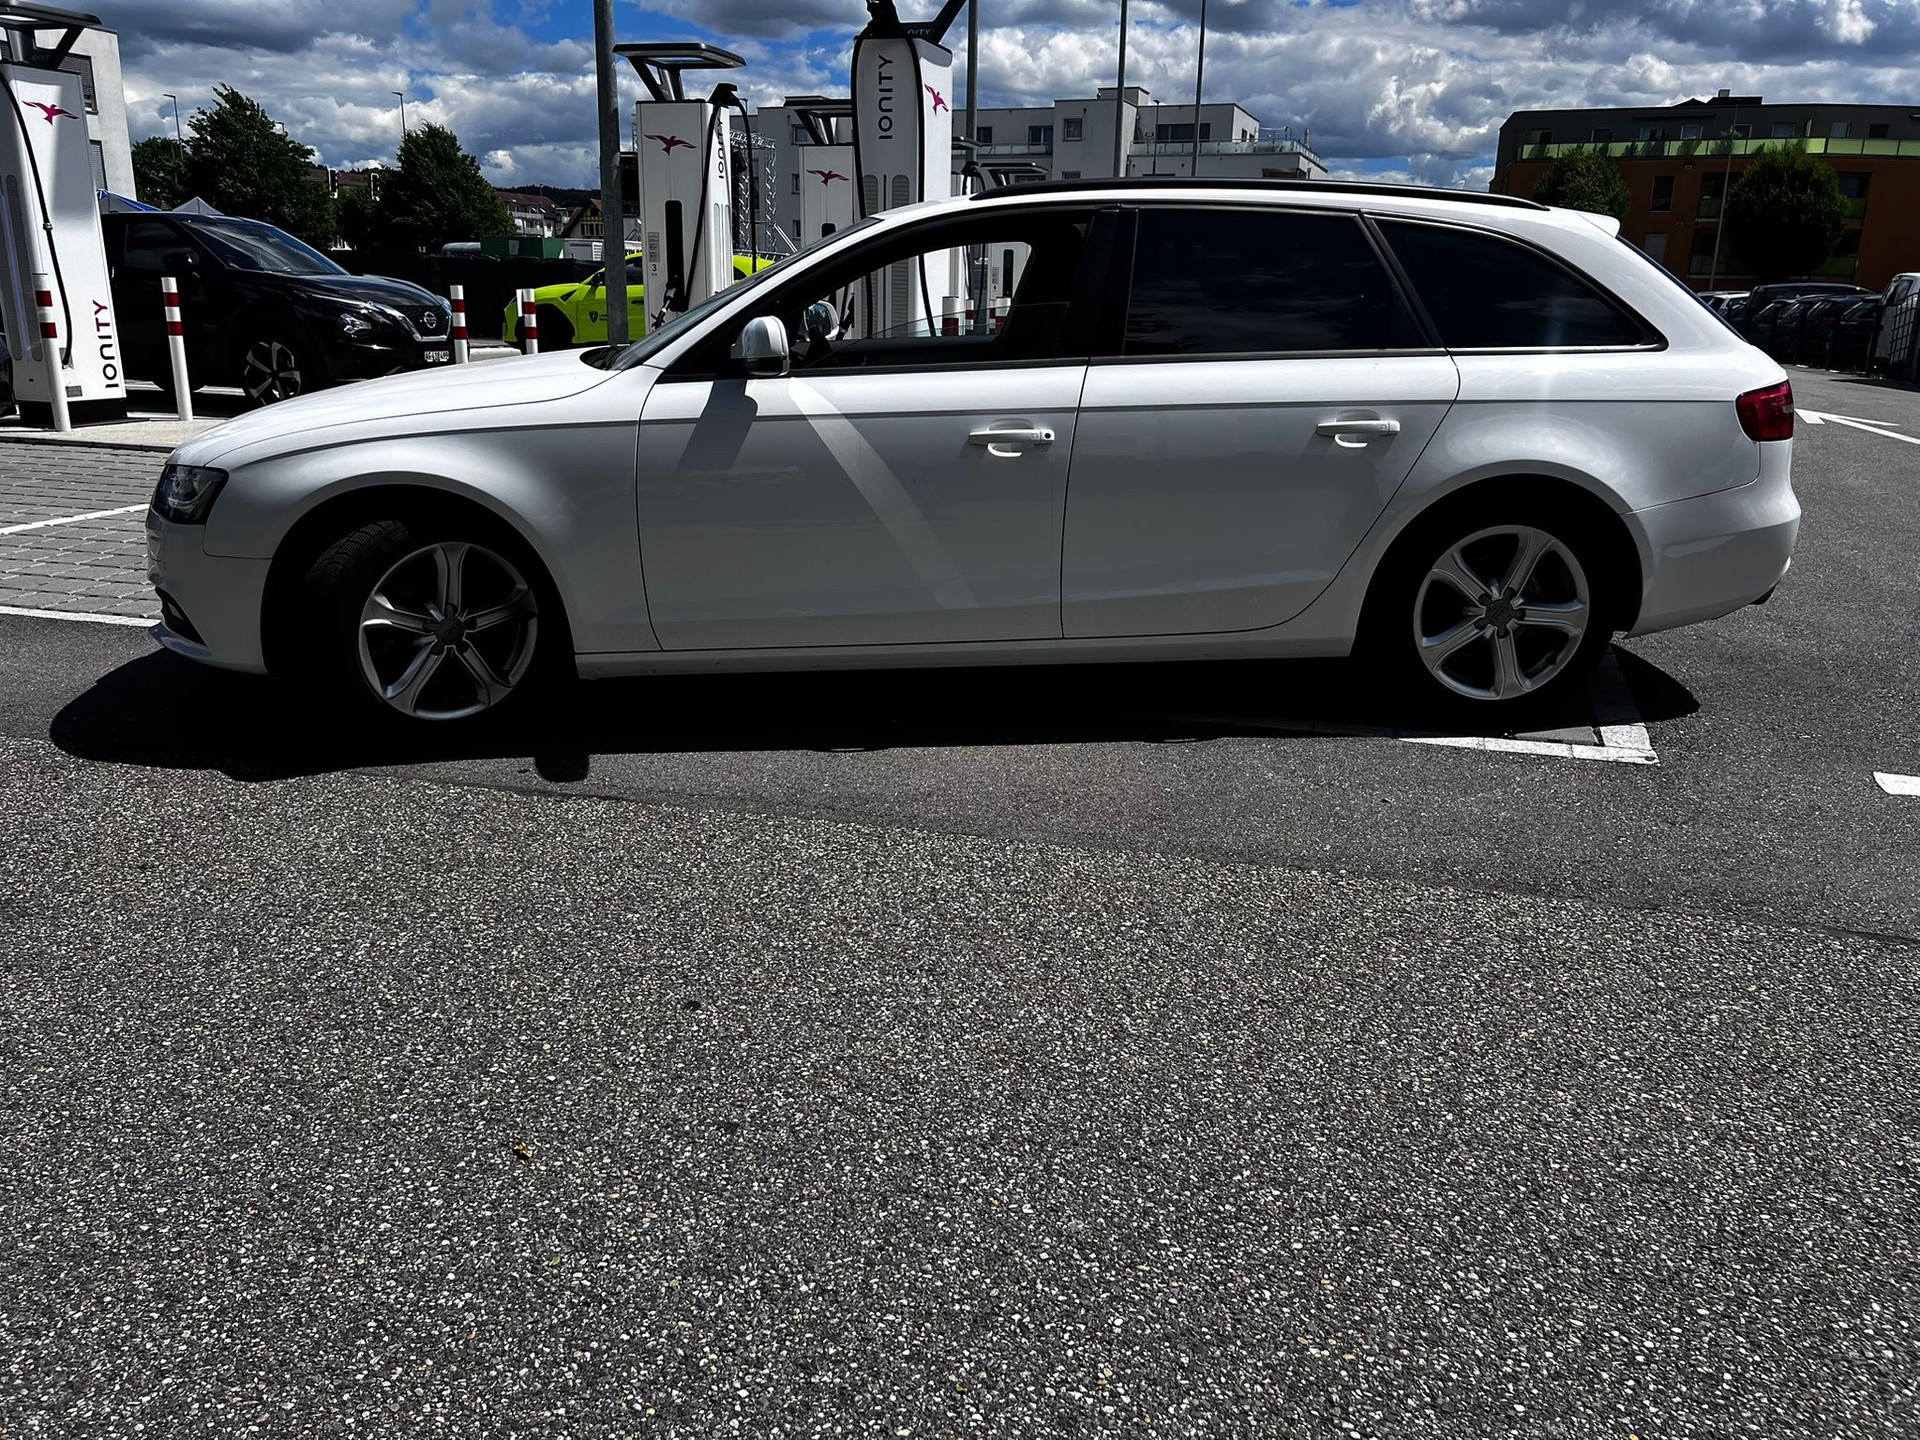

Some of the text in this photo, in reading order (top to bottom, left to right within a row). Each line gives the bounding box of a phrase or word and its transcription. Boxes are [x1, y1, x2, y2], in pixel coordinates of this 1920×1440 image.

[878, 54, 893, 139] IONITY
[651, 263, 657, 272] 3
[92, 299, 119, 388] IONITY
